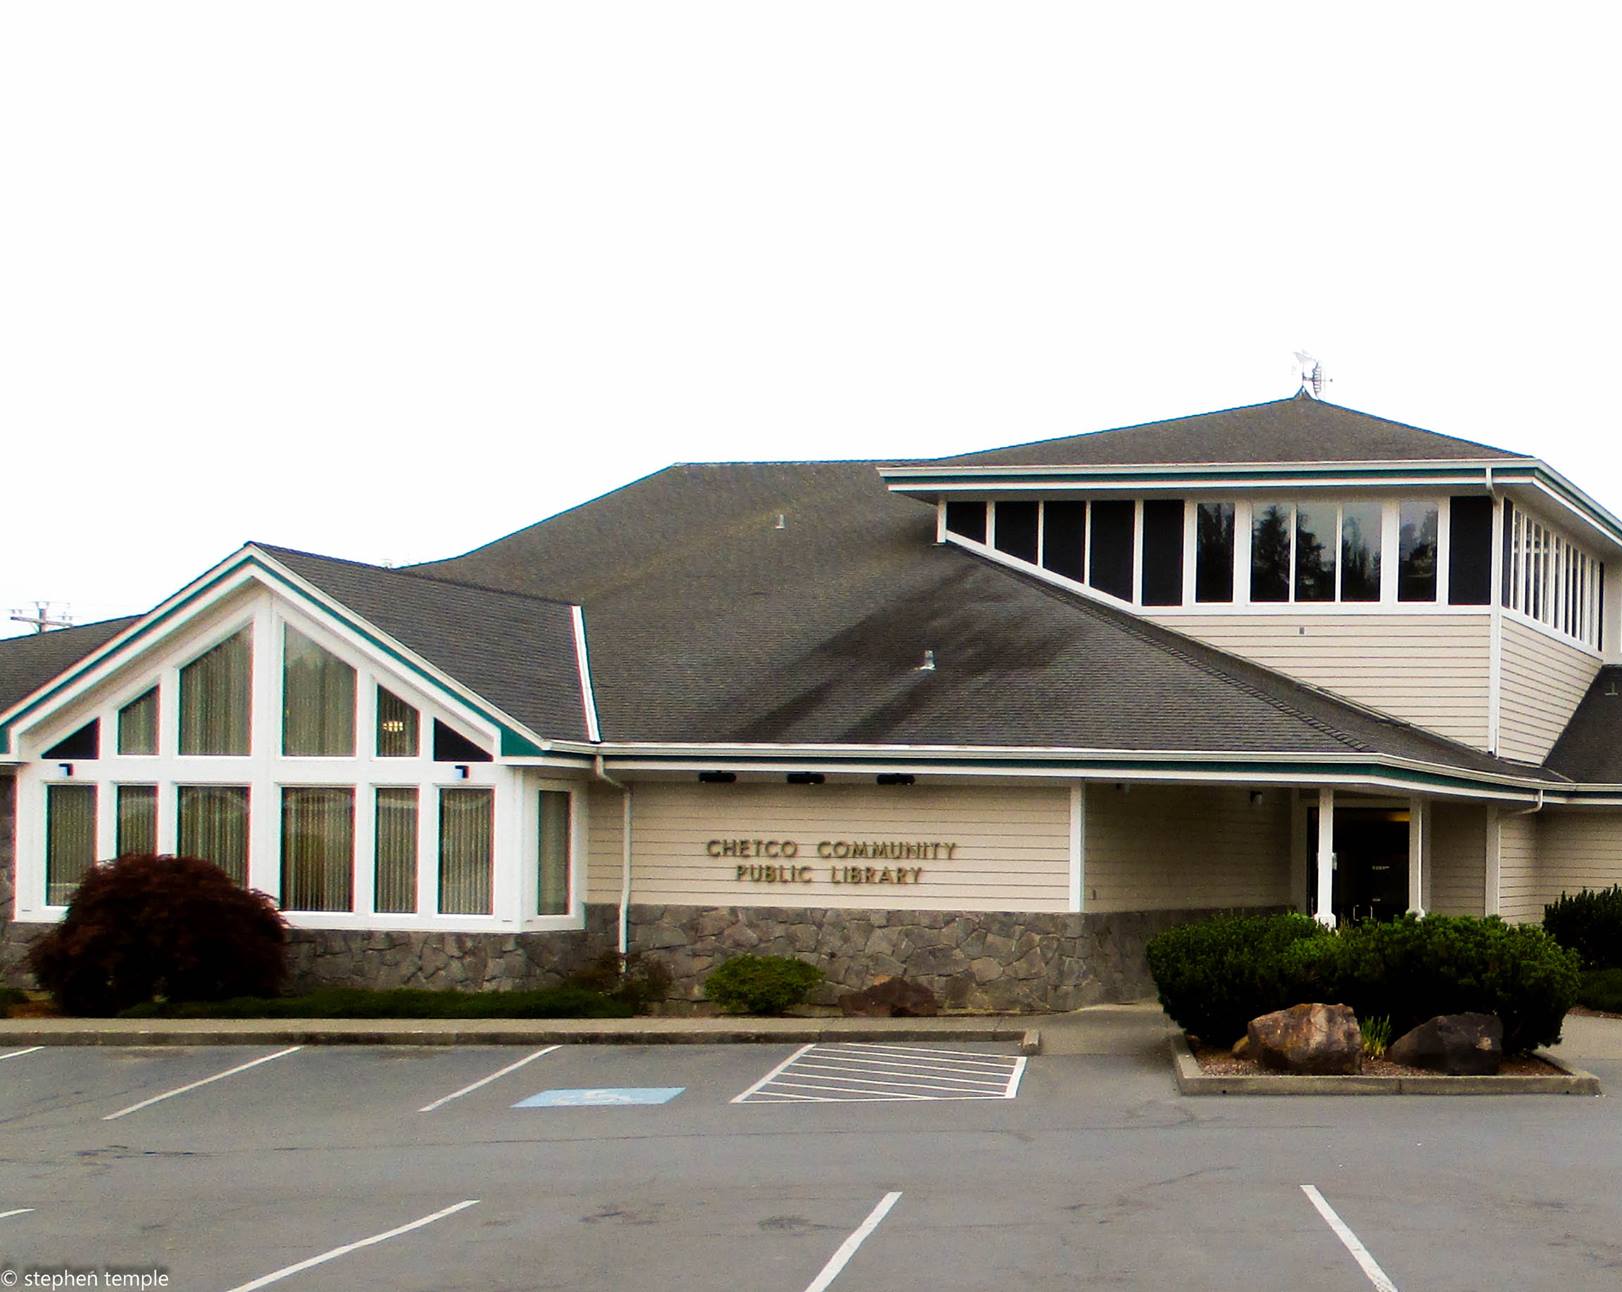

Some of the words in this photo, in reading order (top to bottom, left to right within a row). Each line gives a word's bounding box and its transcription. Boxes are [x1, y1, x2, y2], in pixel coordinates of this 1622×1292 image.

[706, 840, 798, 858] CHETCO
[817, 841, 956, 860] COMMUNITY
[736, 865, 812, 883] PUBLIC
[832, 866, 922, 884] LIBRARY
